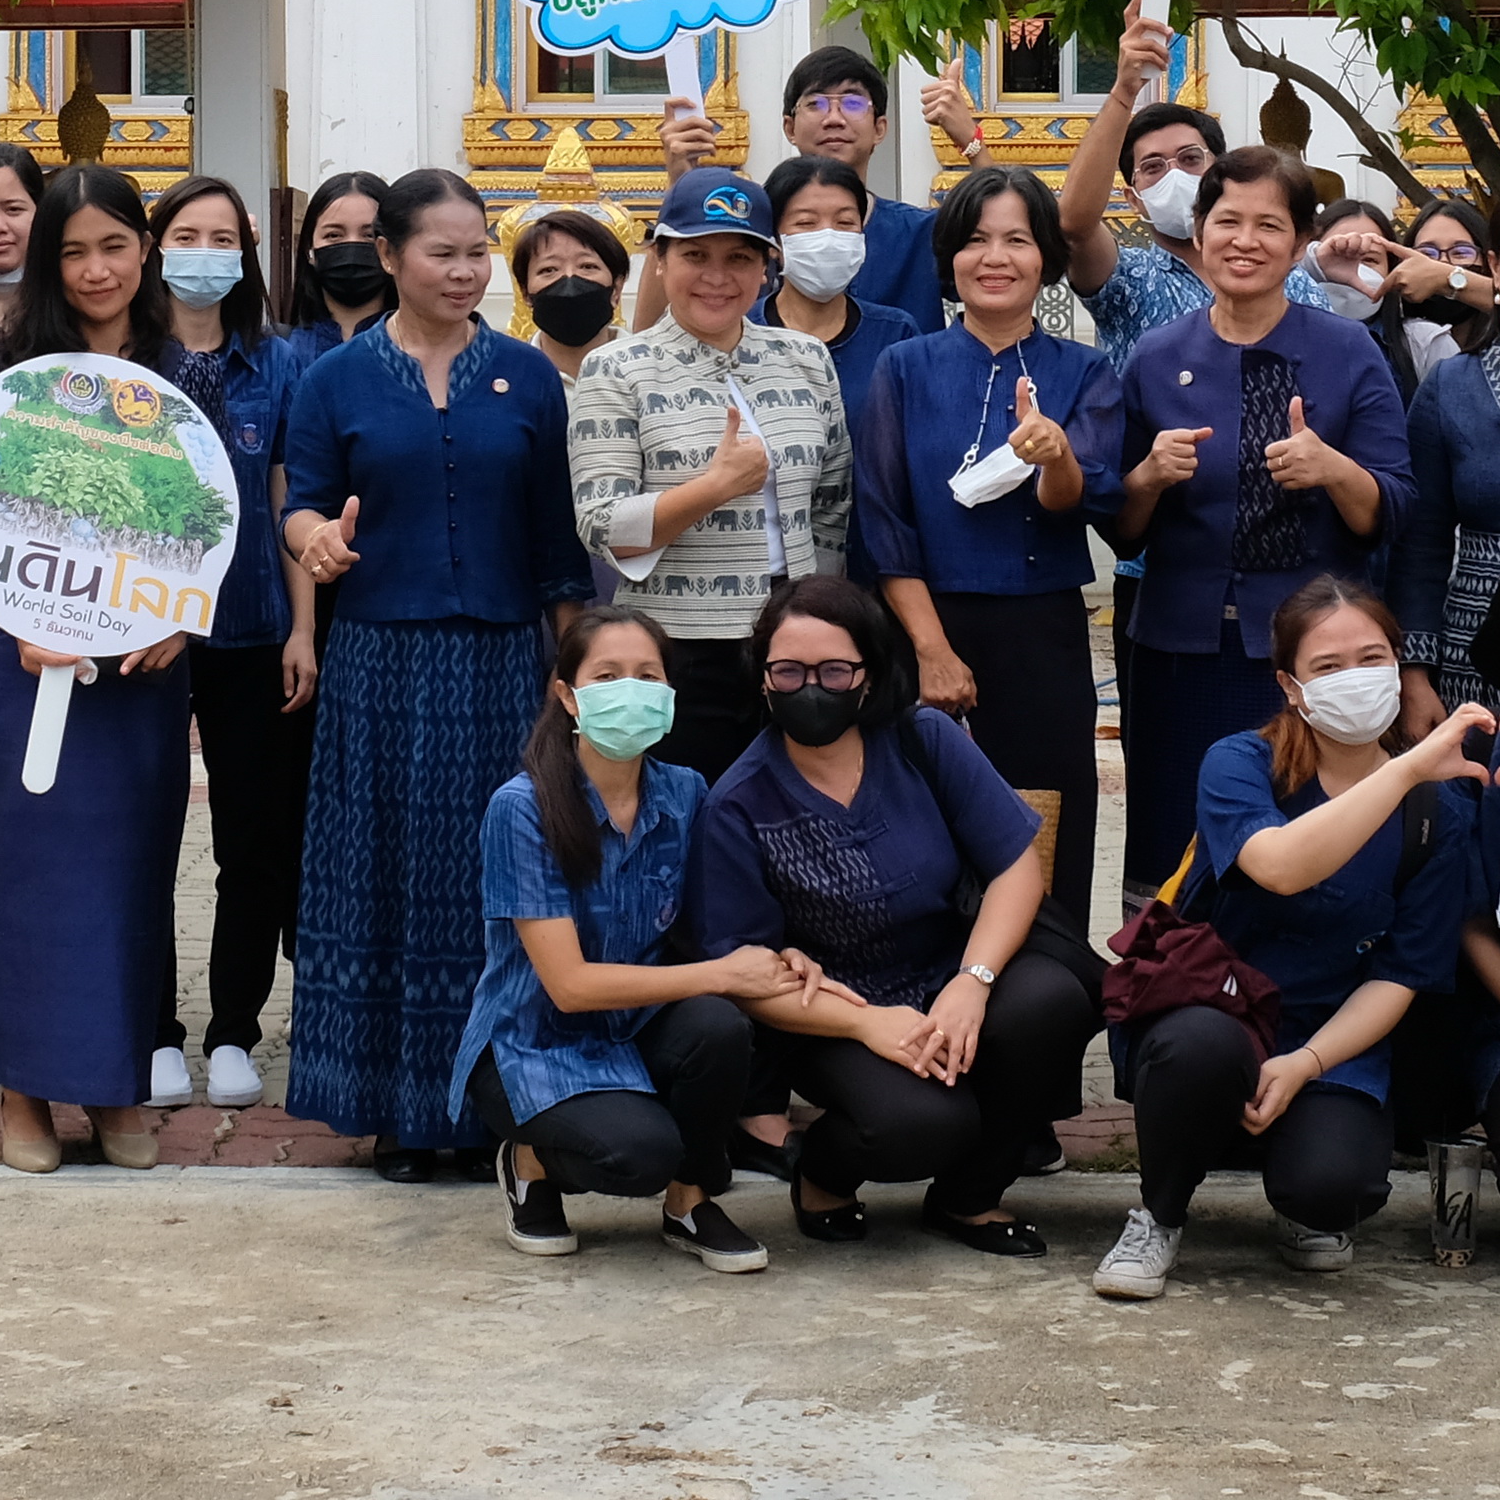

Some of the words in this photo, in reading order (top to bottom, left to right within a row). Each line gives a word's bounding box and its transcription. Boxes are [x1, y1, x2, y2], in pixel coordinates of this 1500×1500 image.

[3, 588, 56, 616] World
[59, 603, 93, 624] Soil
[97, 610, 133, 638] Day
[32, 618, 42, 629] 5
[45, 620, 95, 642] ธันวาคม
